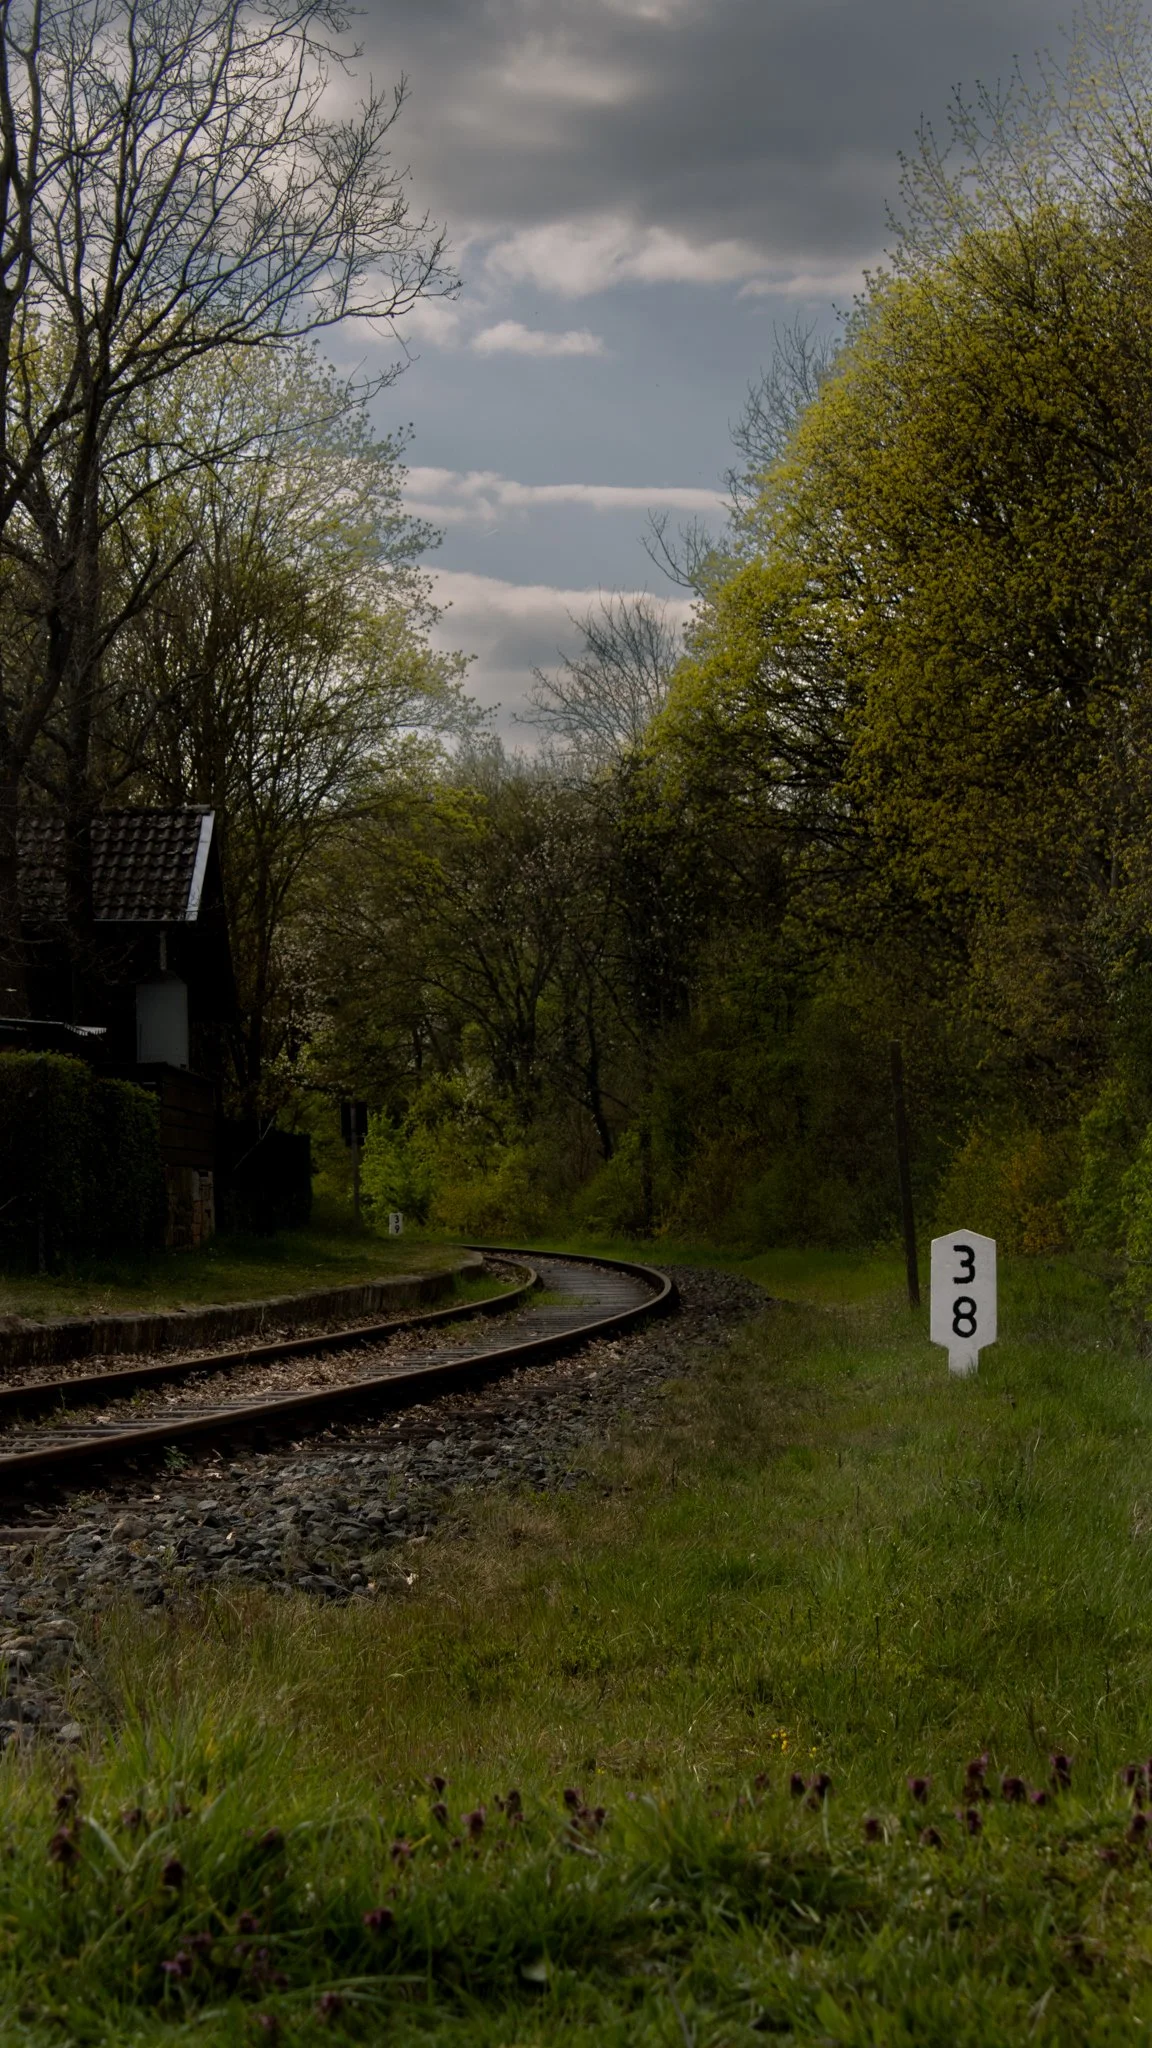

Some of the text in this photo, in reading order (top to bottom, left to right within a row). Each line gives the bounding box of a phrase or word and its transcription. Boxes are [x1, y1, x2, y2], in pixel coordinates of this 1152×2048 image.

[394, 1215, 400, 1223] 3
[394, 1225, 400, 1233] 9
[953, 1245, 975, 1284] 3
[952, 1296, 977, 1338] 8
